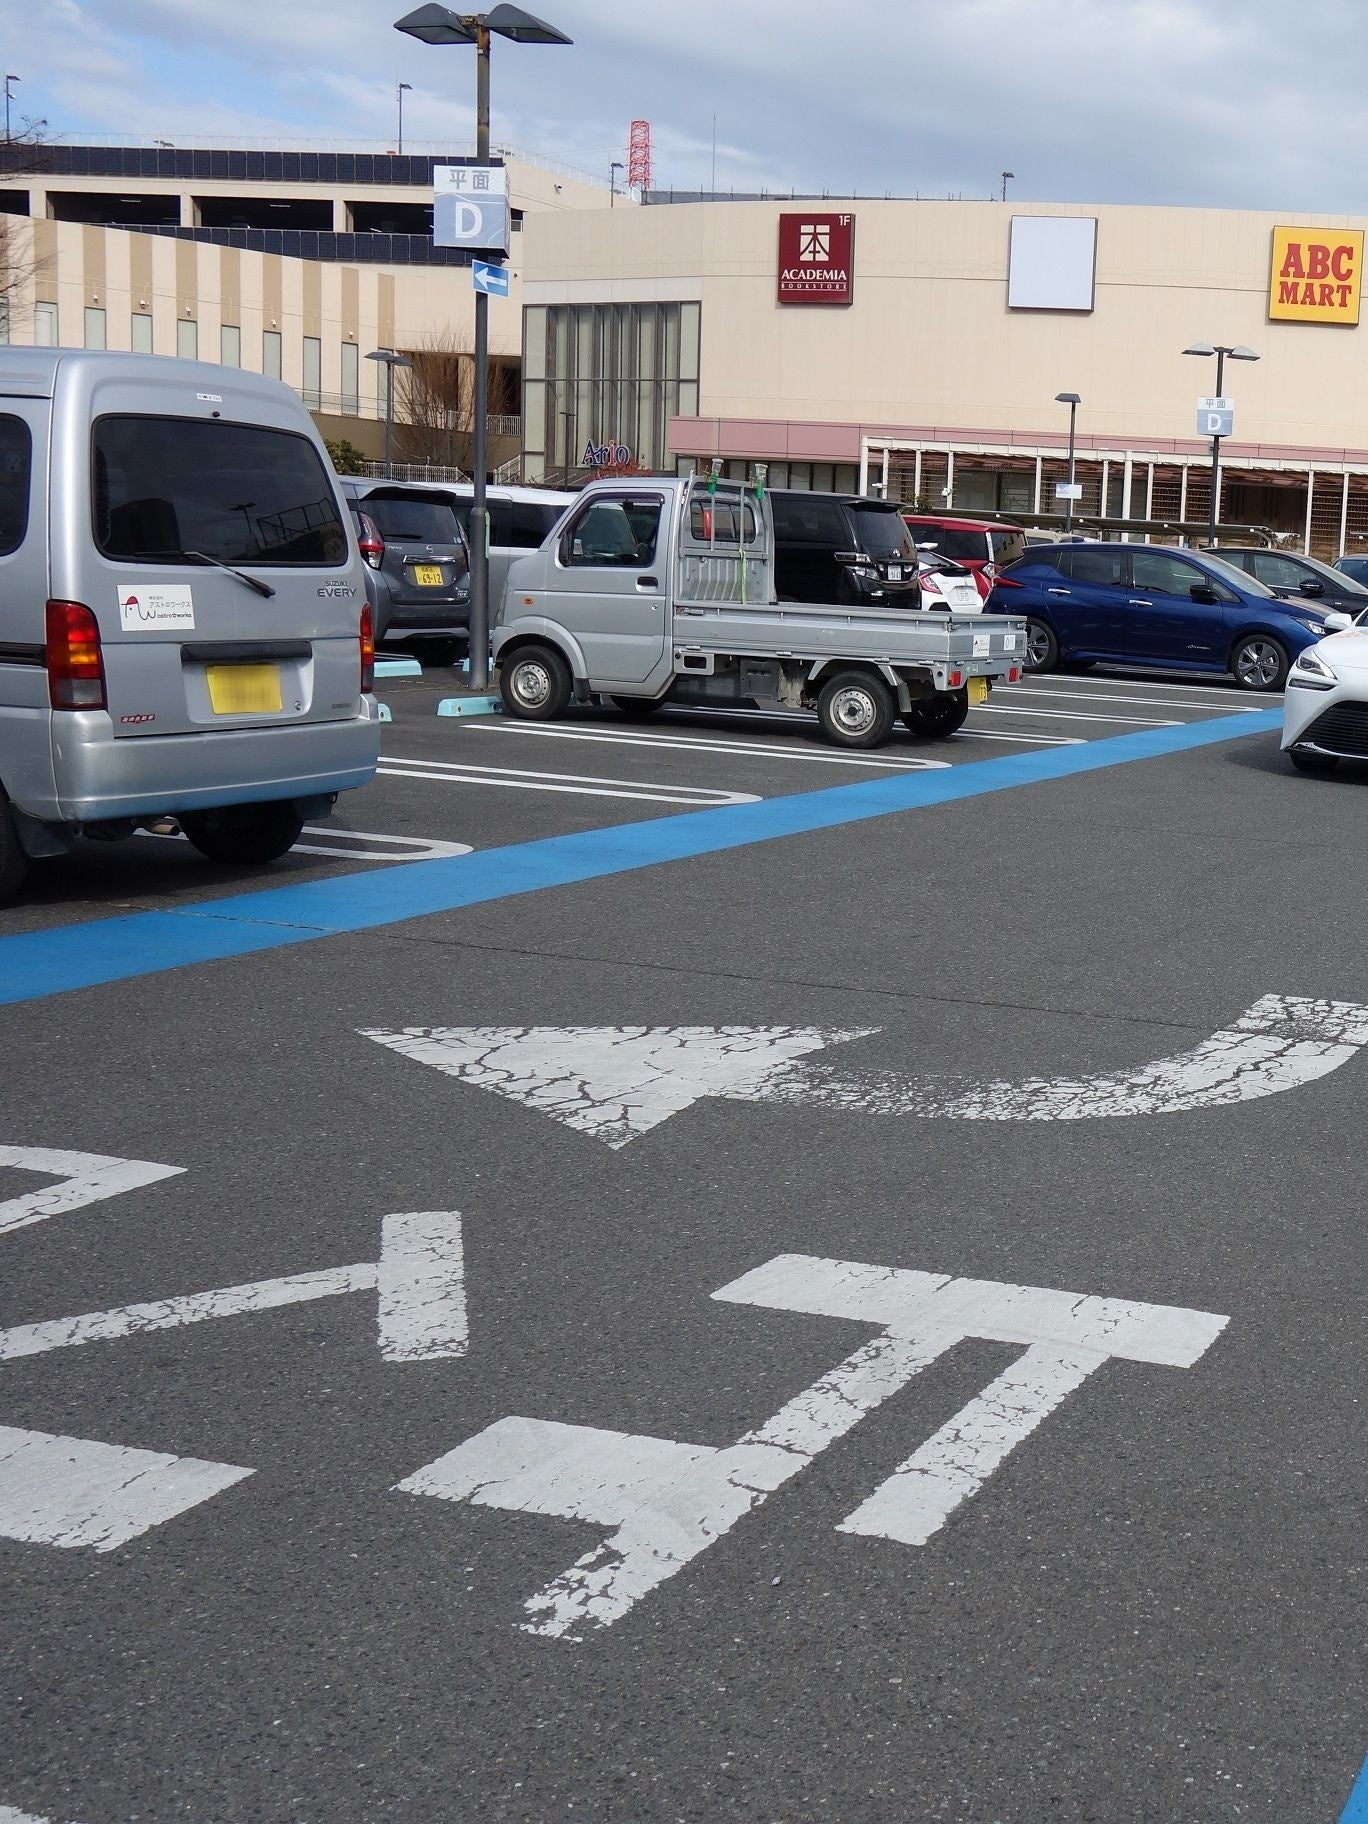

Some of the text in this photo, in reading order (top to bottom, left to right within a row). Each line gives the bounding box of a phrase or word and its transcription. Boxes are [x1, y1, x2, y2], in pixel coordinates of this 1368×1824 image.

[449, 169, 490, 190] 平面
[455, 201, 483, 238] D
[839, 215, 850, 226] 1F
[1280, 243, 1354, 281] ABC
[781, 269, 847, 280] ACADEMIA
[1278, 281, 1352, 308] MART
[1206, 398, 1226, 408] 平面
[1207, 413, 1222, 431] D
[581, 439, 630, 466] Ario
[317, 588, 356, 598] EVERY
